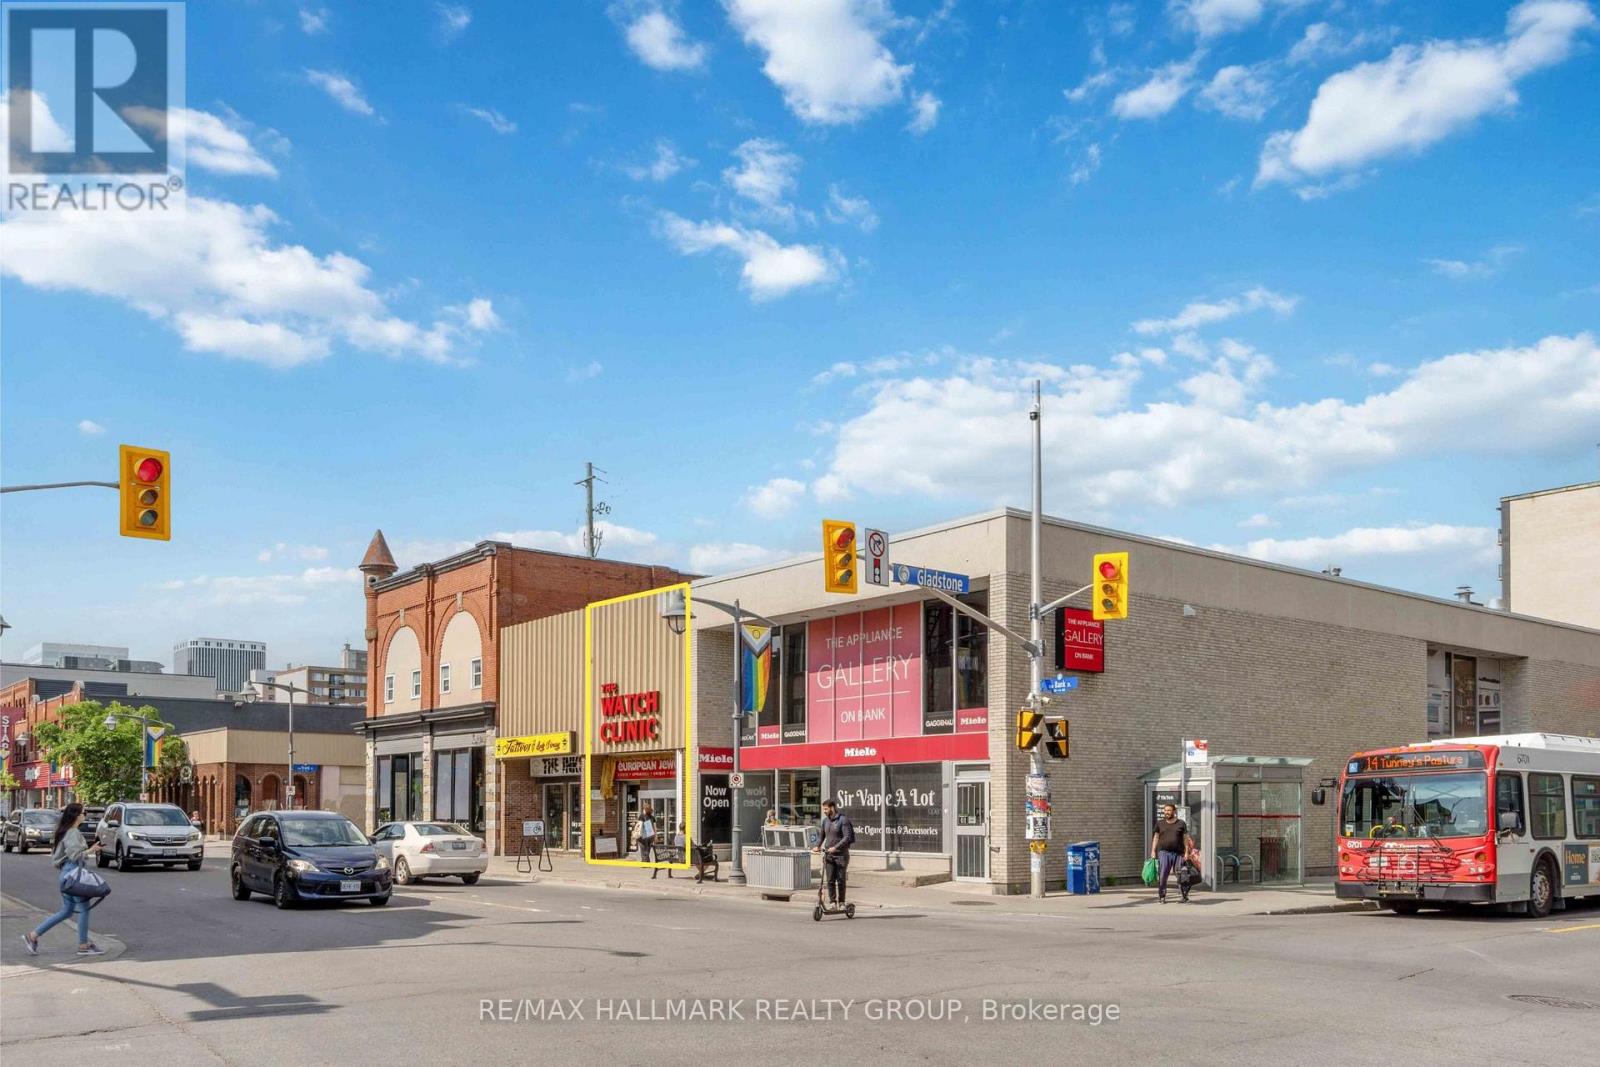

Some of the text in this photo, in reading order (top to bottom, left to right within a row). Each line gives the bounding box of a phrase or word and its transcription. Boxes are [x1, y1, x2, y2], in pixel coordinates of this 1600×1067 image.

[917, 570, 963, 591] Gladstone
[825, 627, 903, 648] THE APPLIANCE
[1064, 628, 1104, 646] GALLERY
[816, 653, 913, 689] GALLERY
[601, 691, 658, 716] WATCH
[841, 708, 885, 723] ON BANK
[960, 716, 987, 725] Miele
[600, 718, 657, 743] CLINIC
[699, 753, 733, 763] Miele
[844, 746, 877, 757] Miele
[1367, 754, 1463, 770] 14 Tunney's Pasture
[705, 785, 727, 796] Now
[703, 797, 730, 809] Open
[837, 789, 854, 808] Sir
[856, 788, 892, 811] Vape
[894, 788, 908, 808] A
[909, 788, 936, 807] Lot
